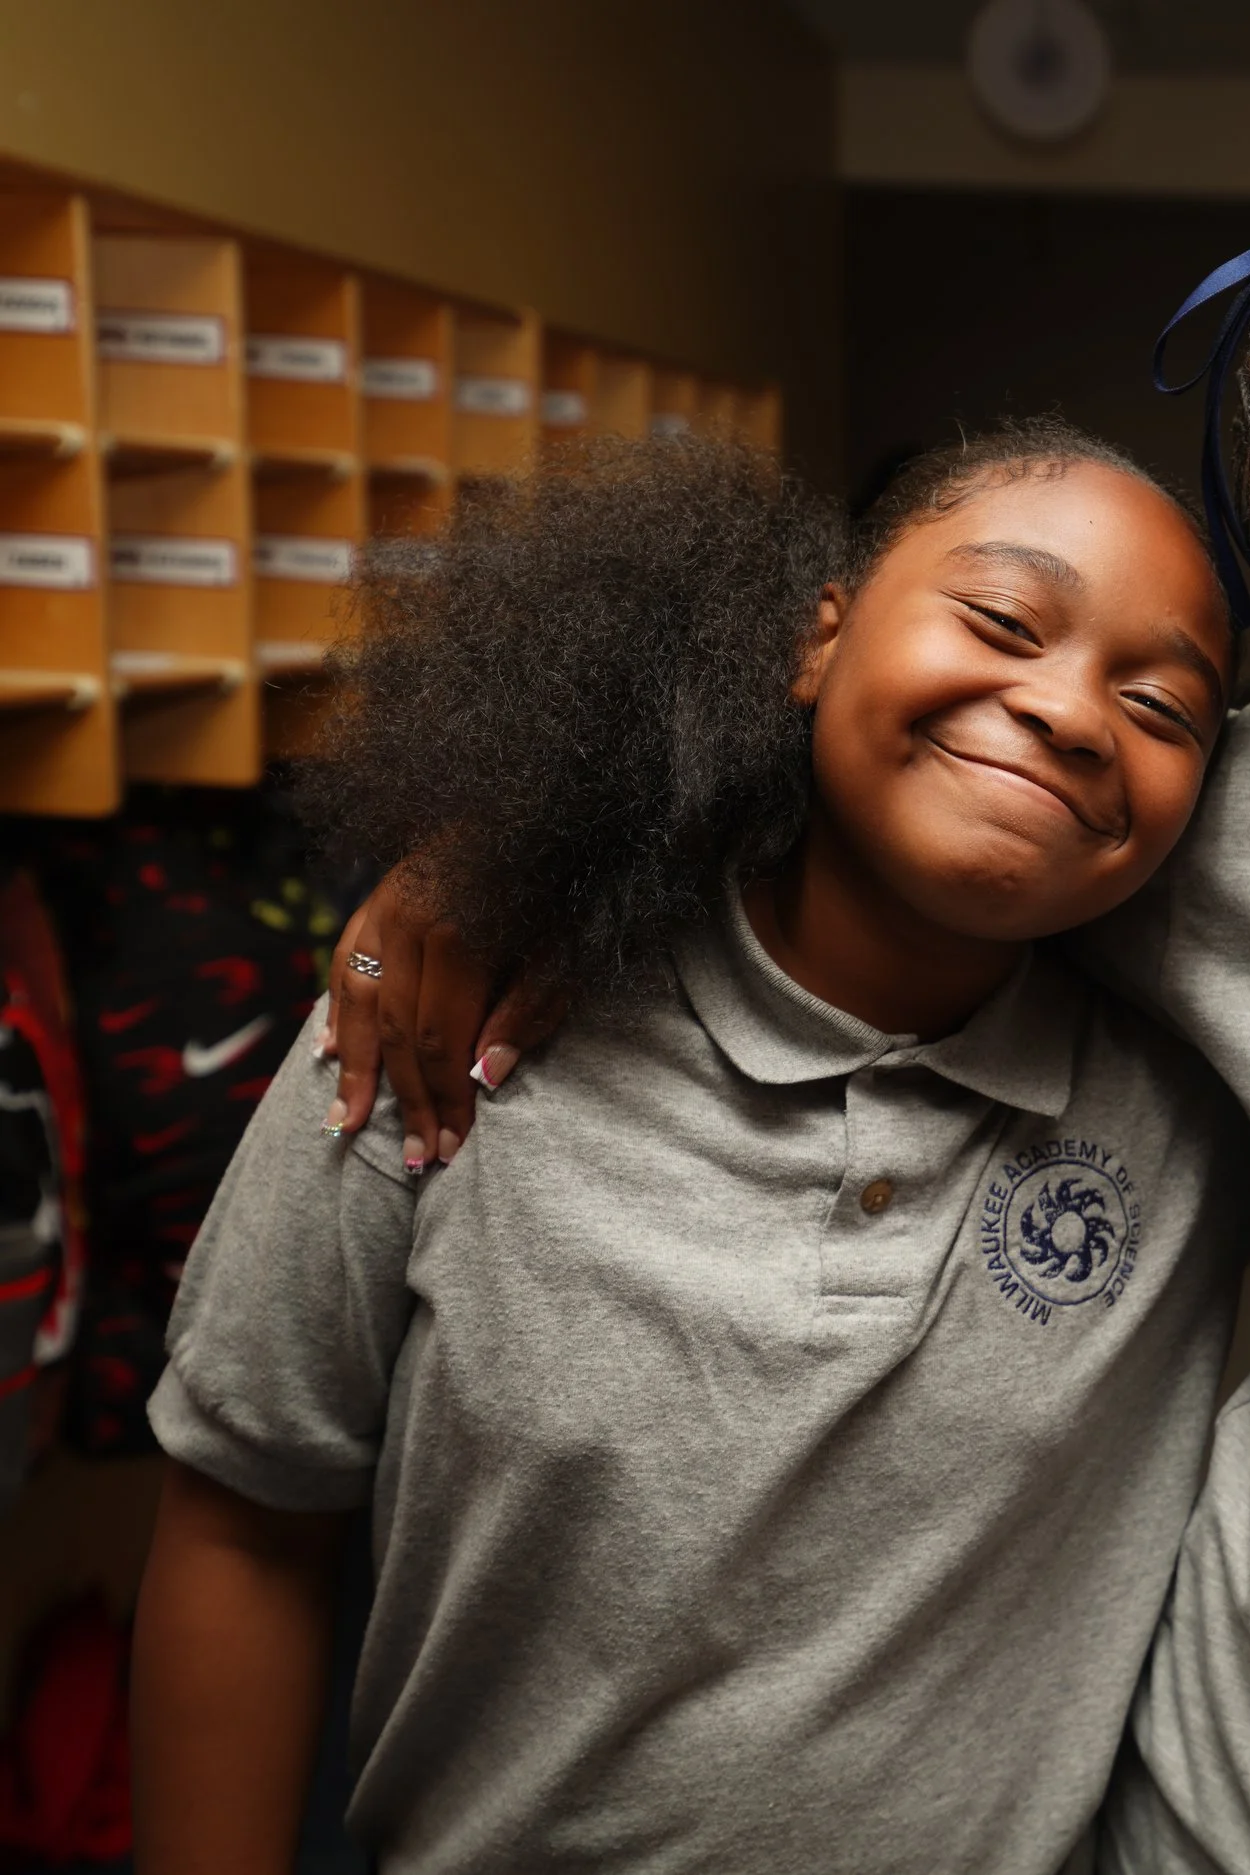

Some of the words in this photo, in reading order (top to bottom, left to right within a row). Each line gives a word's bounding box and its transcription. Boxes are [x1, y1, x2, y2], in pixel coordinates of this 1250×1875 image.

[1003, 1139, 1112, 1184] ACADEMY
[1115, 1166, 1137, 1195] OF
[981, 1182, 1052, 1326] MILWAUKEE
[1102, 1203, 1142, 1308] SCIENCE
